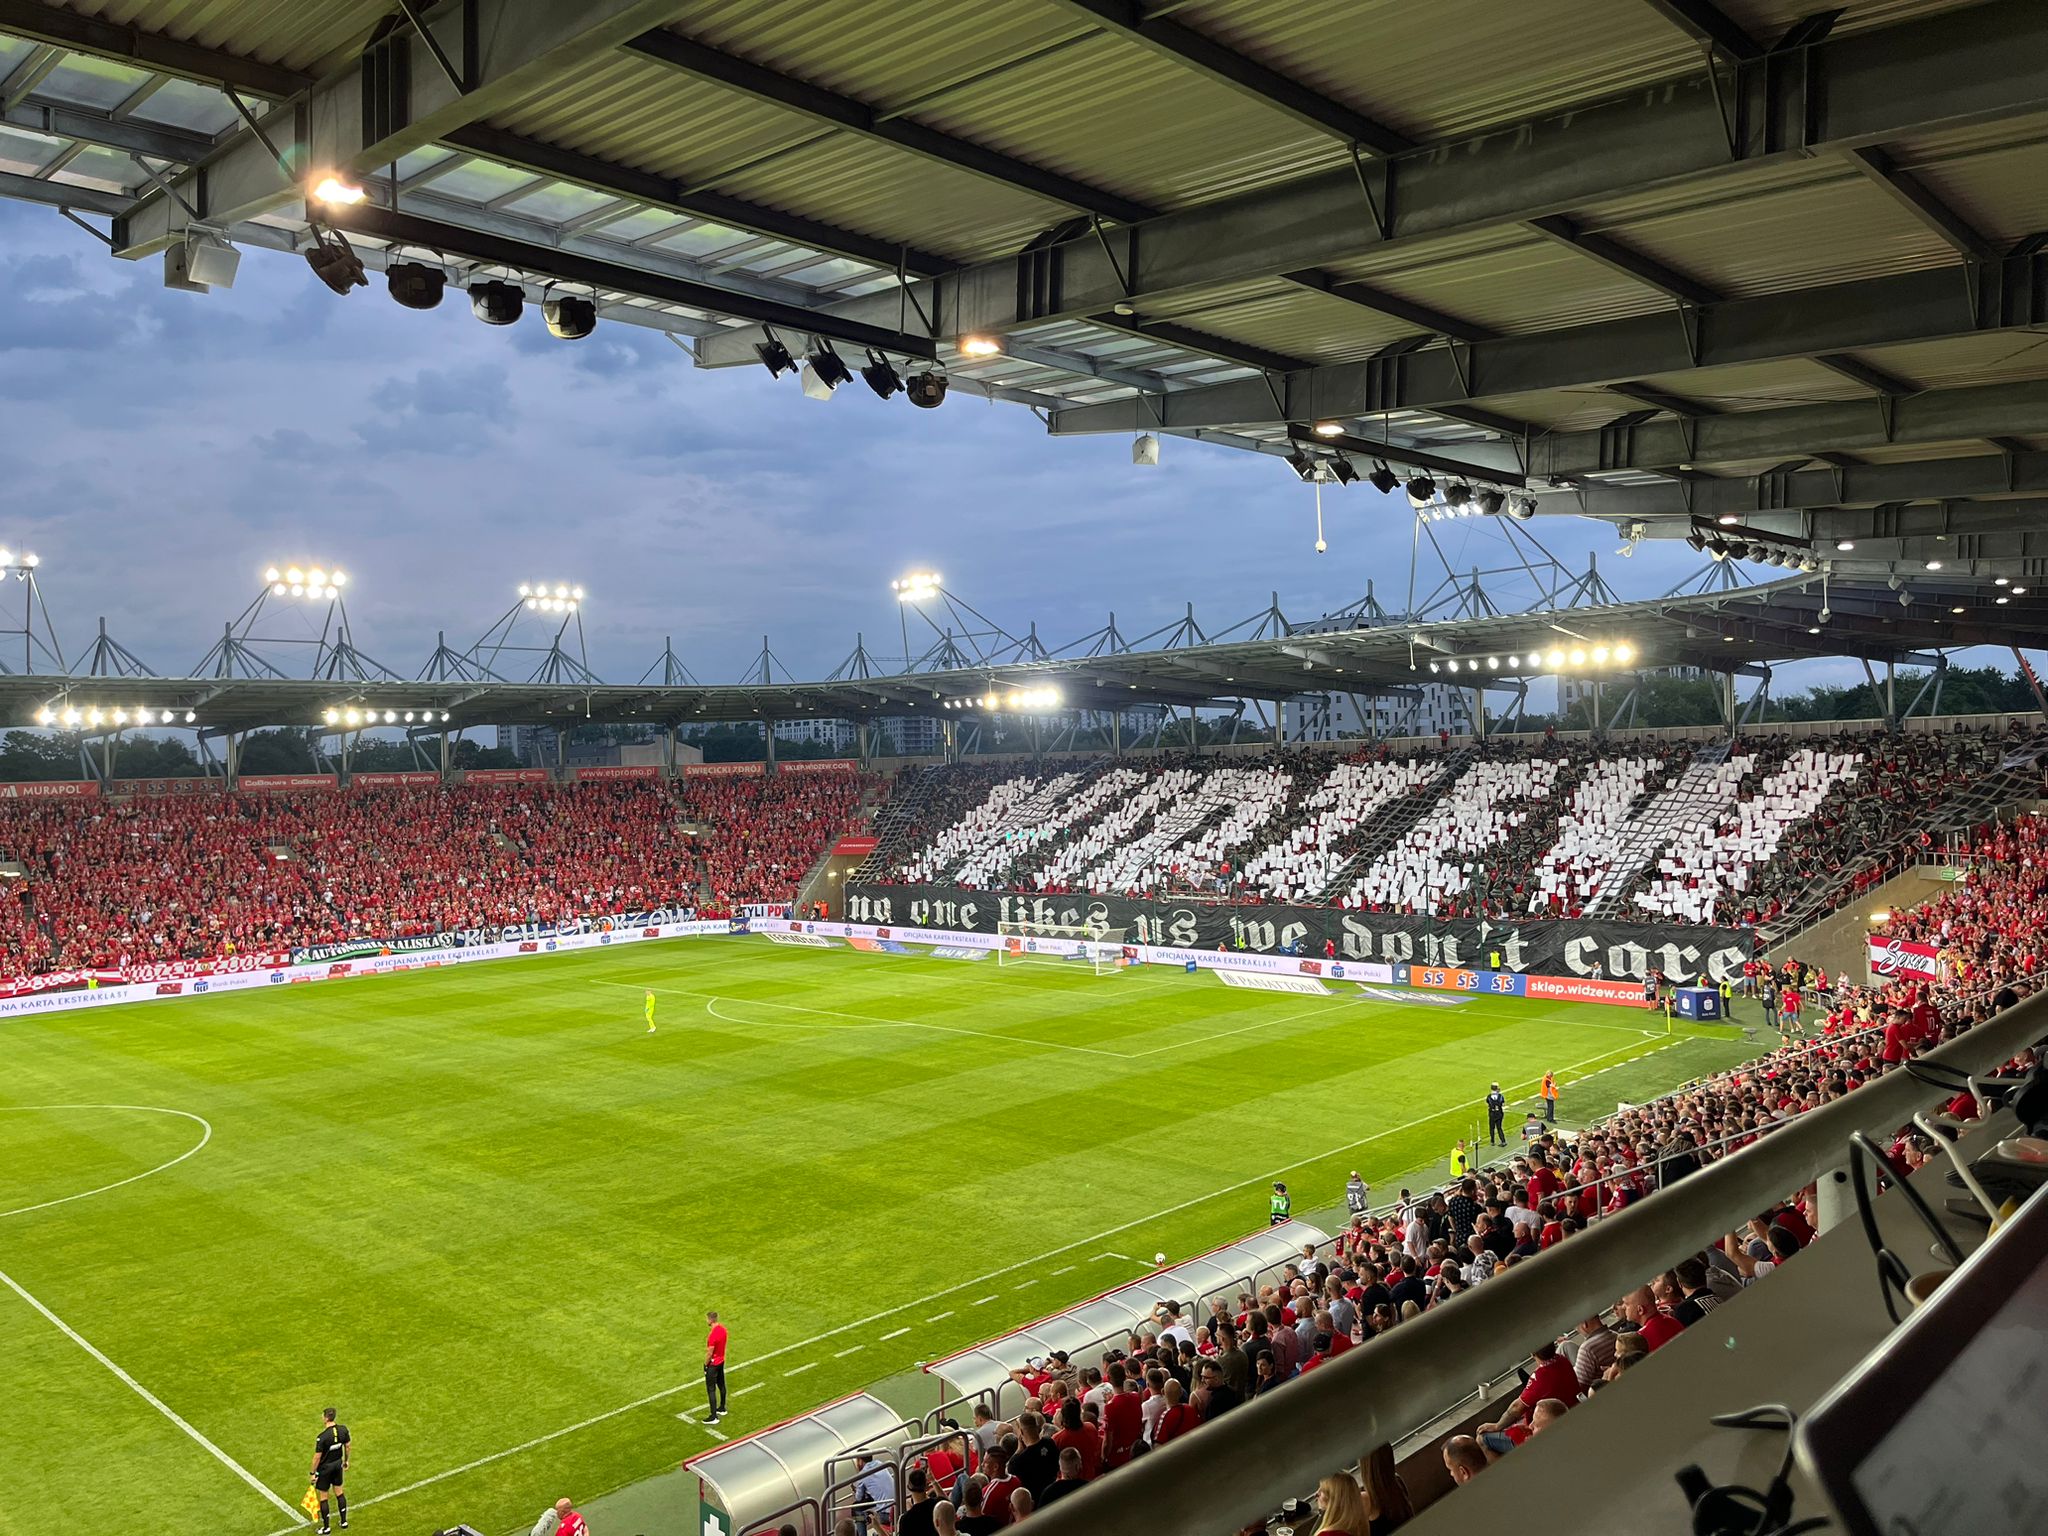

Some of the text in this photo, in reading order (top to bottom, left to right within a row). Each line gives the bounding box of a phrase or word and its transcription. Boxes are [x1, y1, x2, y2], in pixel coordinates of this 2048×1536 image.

[581, 767, 655, 778] www.etpromo.pl
[732, 764, 761, 774] ZDRÓJ
[23, 784, 82, 796] MURAPOL
[385, 936, 440, 950] KALISKA
[849, 895, 1749, 987] no one likes us we don't care
[374, 946, 499, 967] OFICJALNA KARTA EKSTRAKLASY
[1156, 951, 1277, 968] OFICJALNA KARTA EKSTRAKLASY
[1878, 939, 1929, 974] Serce
[119, 959, 199, 982] WIDZEW
[1423, 970, 1445, 986] STS
[1238, 976, 1319, 994] PANATTONI
[1457, 972, 1479, 989] STS
[1491, 974, 1514, 991] STS
[1530, 981, 1647, 1001] sklep.widzew.com
[21, 999, 55, 1009] KARTA
[58, 991, 128, 1005] EKSTRAKLASY
[1272, 1199, 1287, 1210] TV
